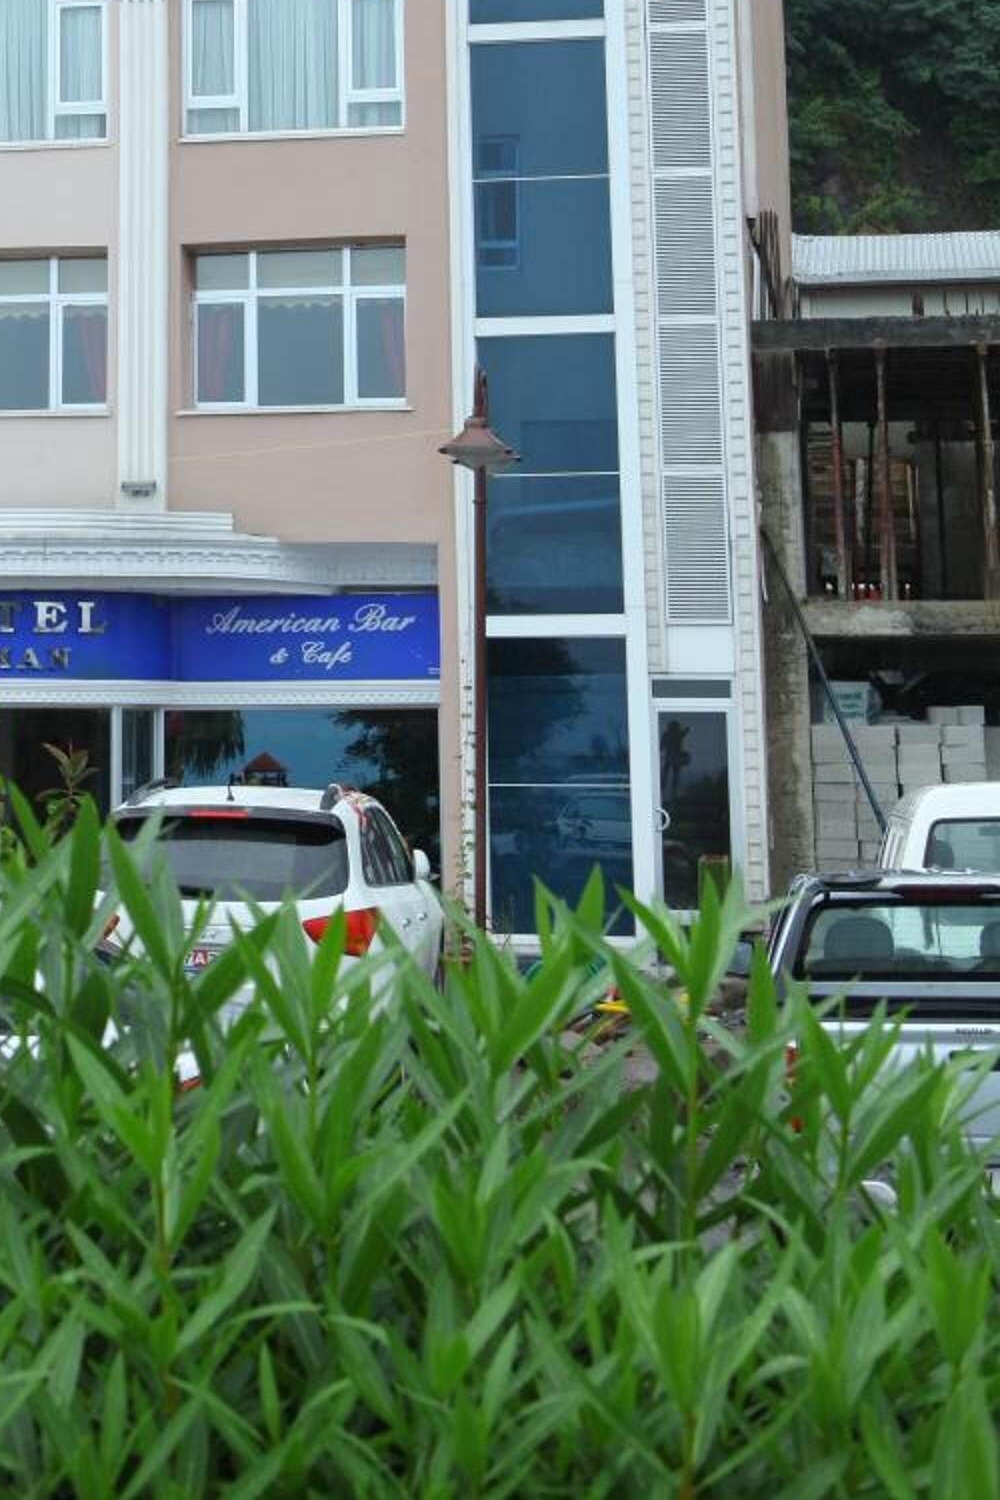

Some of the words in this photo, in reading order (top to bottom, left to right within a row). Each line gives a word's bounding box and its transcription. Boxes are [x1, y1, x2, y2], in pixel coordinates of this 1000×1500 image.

[206, 606, 340, 634] American
[349, 603, 416, 632] Bar
[269, 648, 289, 664] &
[301, 641, 353, 670] Cafe
